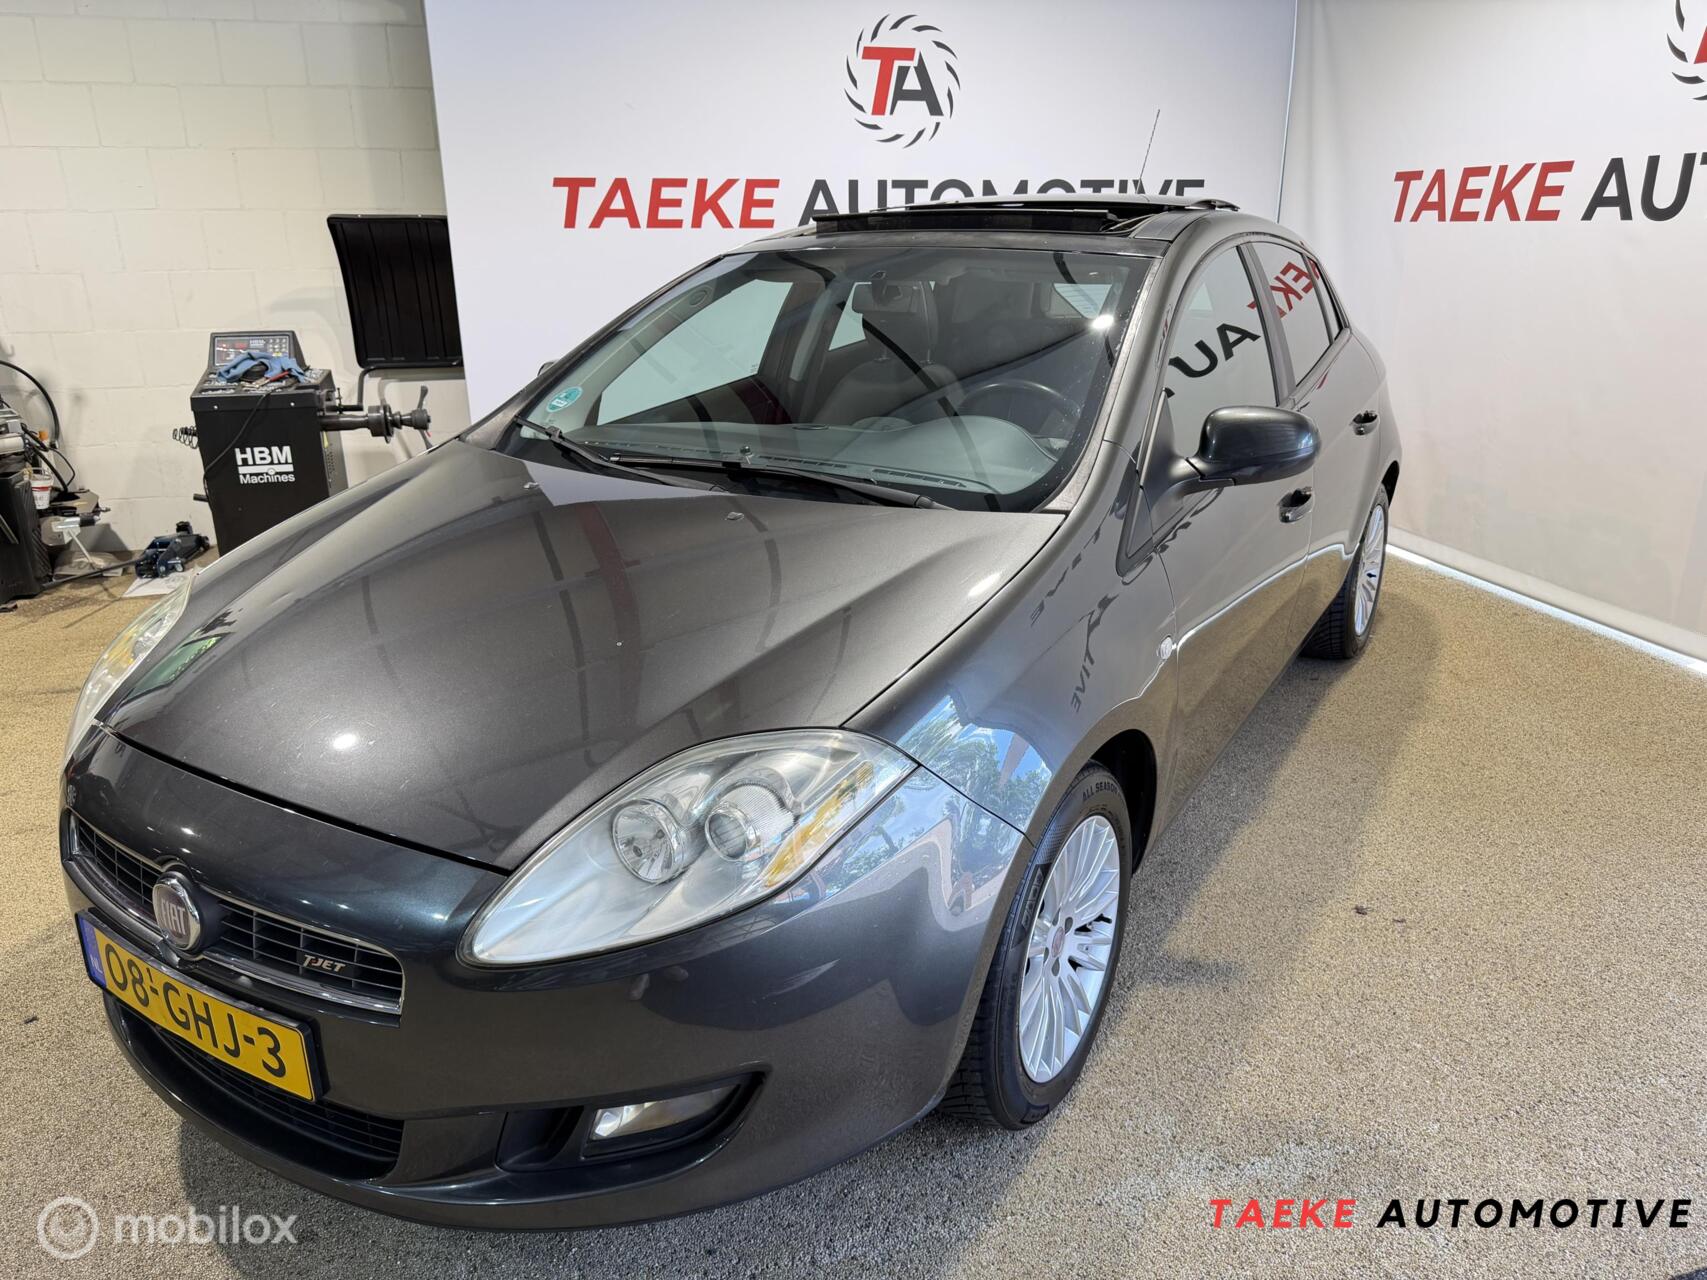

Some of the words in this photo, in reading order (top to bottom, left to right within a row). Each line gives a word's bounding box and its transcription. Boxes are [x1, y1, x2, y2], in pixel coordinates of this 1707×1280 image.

[553, 178, 780, 229] TAEKE
[1394, 160, 1575, 222] TAEKE
[1580, 152, 1707, 222] AU
[235, 446, 293, 466] HBM
[239, 472, 296, 485] Machines
[161, 897, 186, 936] FIAT
[90, 954, 104, 975] NL
[104, 943, 287, 1078] 08-GHJ-3
